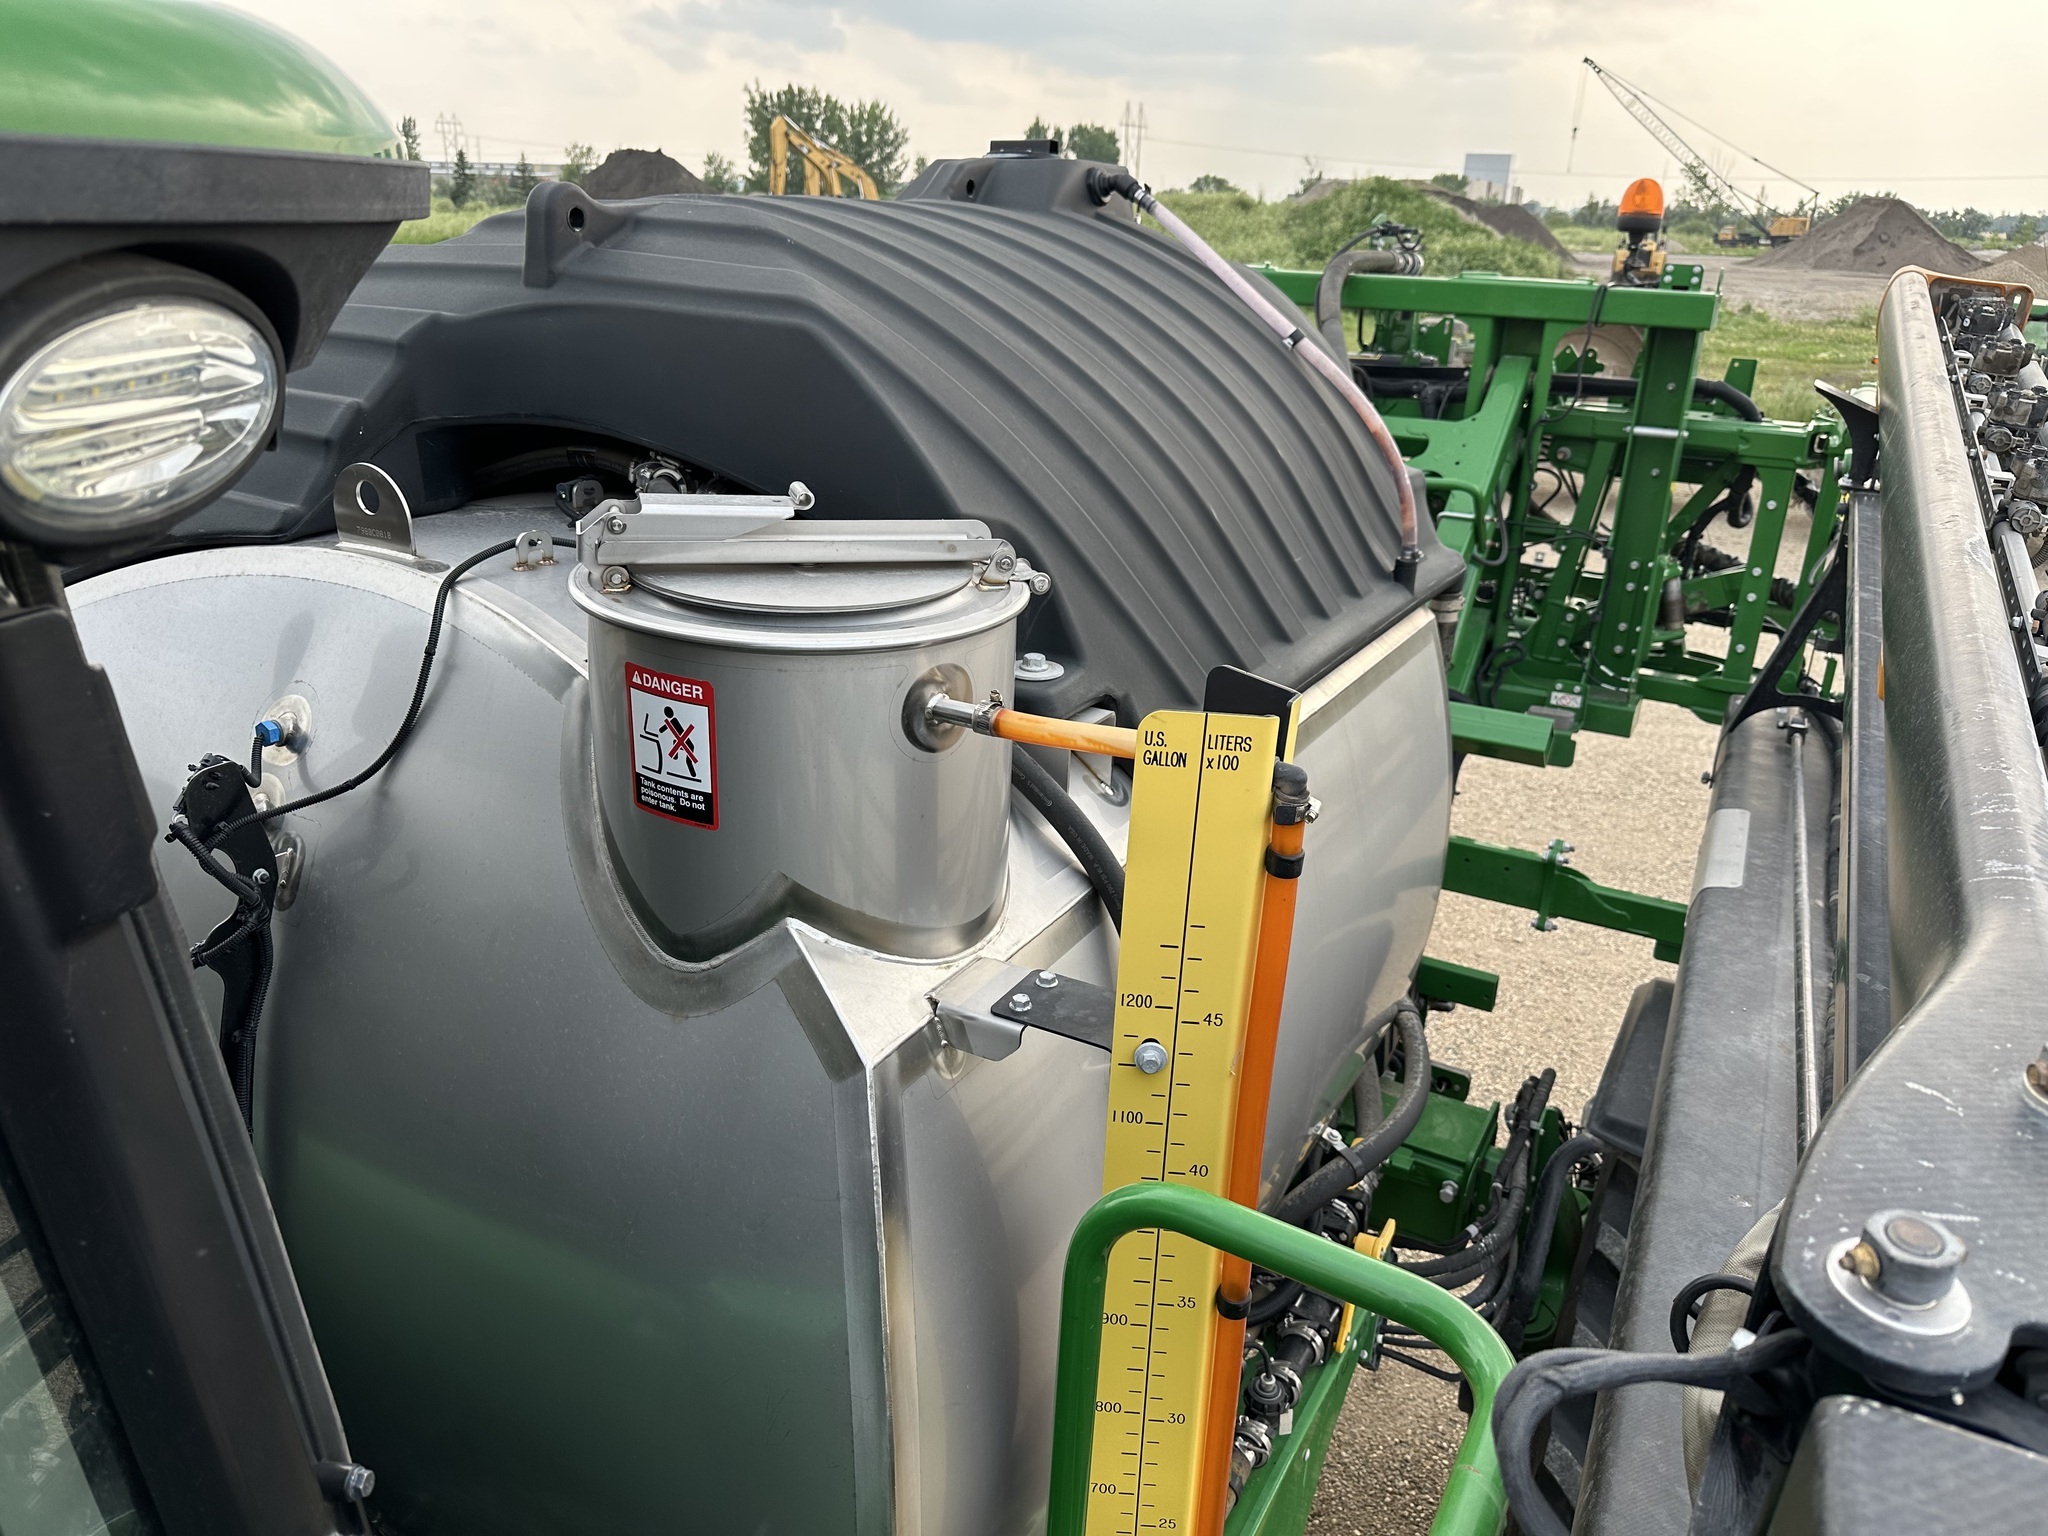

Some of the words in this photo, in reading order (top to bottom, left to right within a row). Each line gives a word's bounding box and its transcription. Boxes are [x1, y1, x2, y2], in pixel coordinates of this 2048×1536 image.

[642, 673, 703, 700] DANGER
[1144, 730, 1167, 748] U.S.
[1207, 734, 1253, 752] LITERS
[1143, 750, 1187, 768] GALLON
[1206, 754, 1239, 771] x100
[640, 776, 656, 790] Tank
[656, 784, 689, 799] contents
[690, 793, 704, 802] are
[640, 786, 677, 804] poisonous.
[679, 797, 691, 807] Do
[691, 802, 706, 811] not
[641, 794, 658, 806] enter
[658, 800, 677, 812] tank.
[1067, 825, 1078, 839] USA
[1081, 843, 1095, 860] MADE
[1120, 993, 1153, 1009] 1200
[1202, 1012, 1224, 1027] 45
[1112, 1109, 1143, 1124] 1100
[1188, 1164, 1209, 1178] 40
[1176, 1295, 1196, 1309] 35
[1102, 1312, 1128, 1326] 900
[1095, 1400, 1122, 1414] 800
[1167, 1412, 1186, 1425] 30
[1090, 1482, 1117, 1495] 700
[1158, 1518, 1177, 1530] 25
